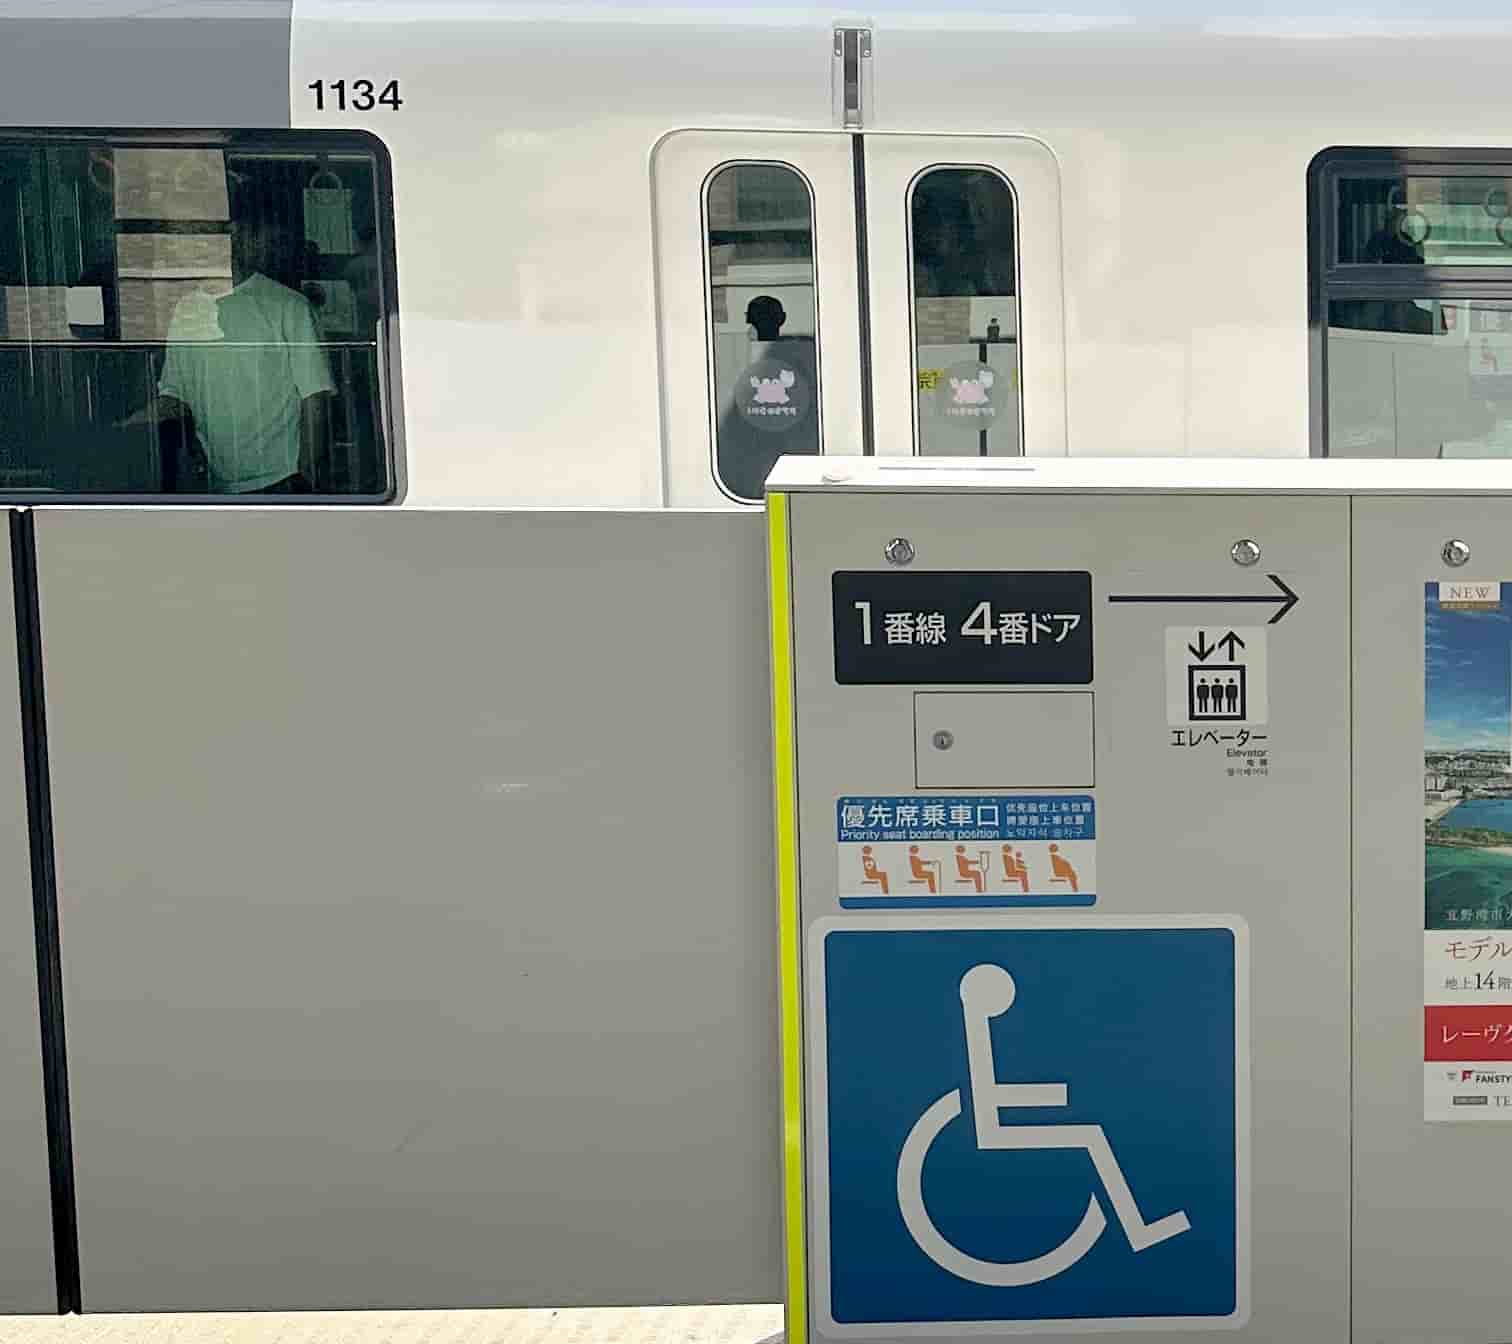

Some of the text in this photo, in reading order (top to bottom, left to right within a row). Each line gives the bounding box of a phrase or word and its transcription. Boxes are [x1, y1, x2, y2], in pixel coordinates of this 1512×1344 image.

[308, 79, 403, 112] 1134
[1450, 586, 1489, 599] NEW
[854, 601, 1081, 646] 1番線 4番ドア
[1171, 728, 1268, 747] エレベーター
[840, 805, 1000, 828] 優先席乗車口
[840, 829, 1000, 841] Priority seat boarding position
